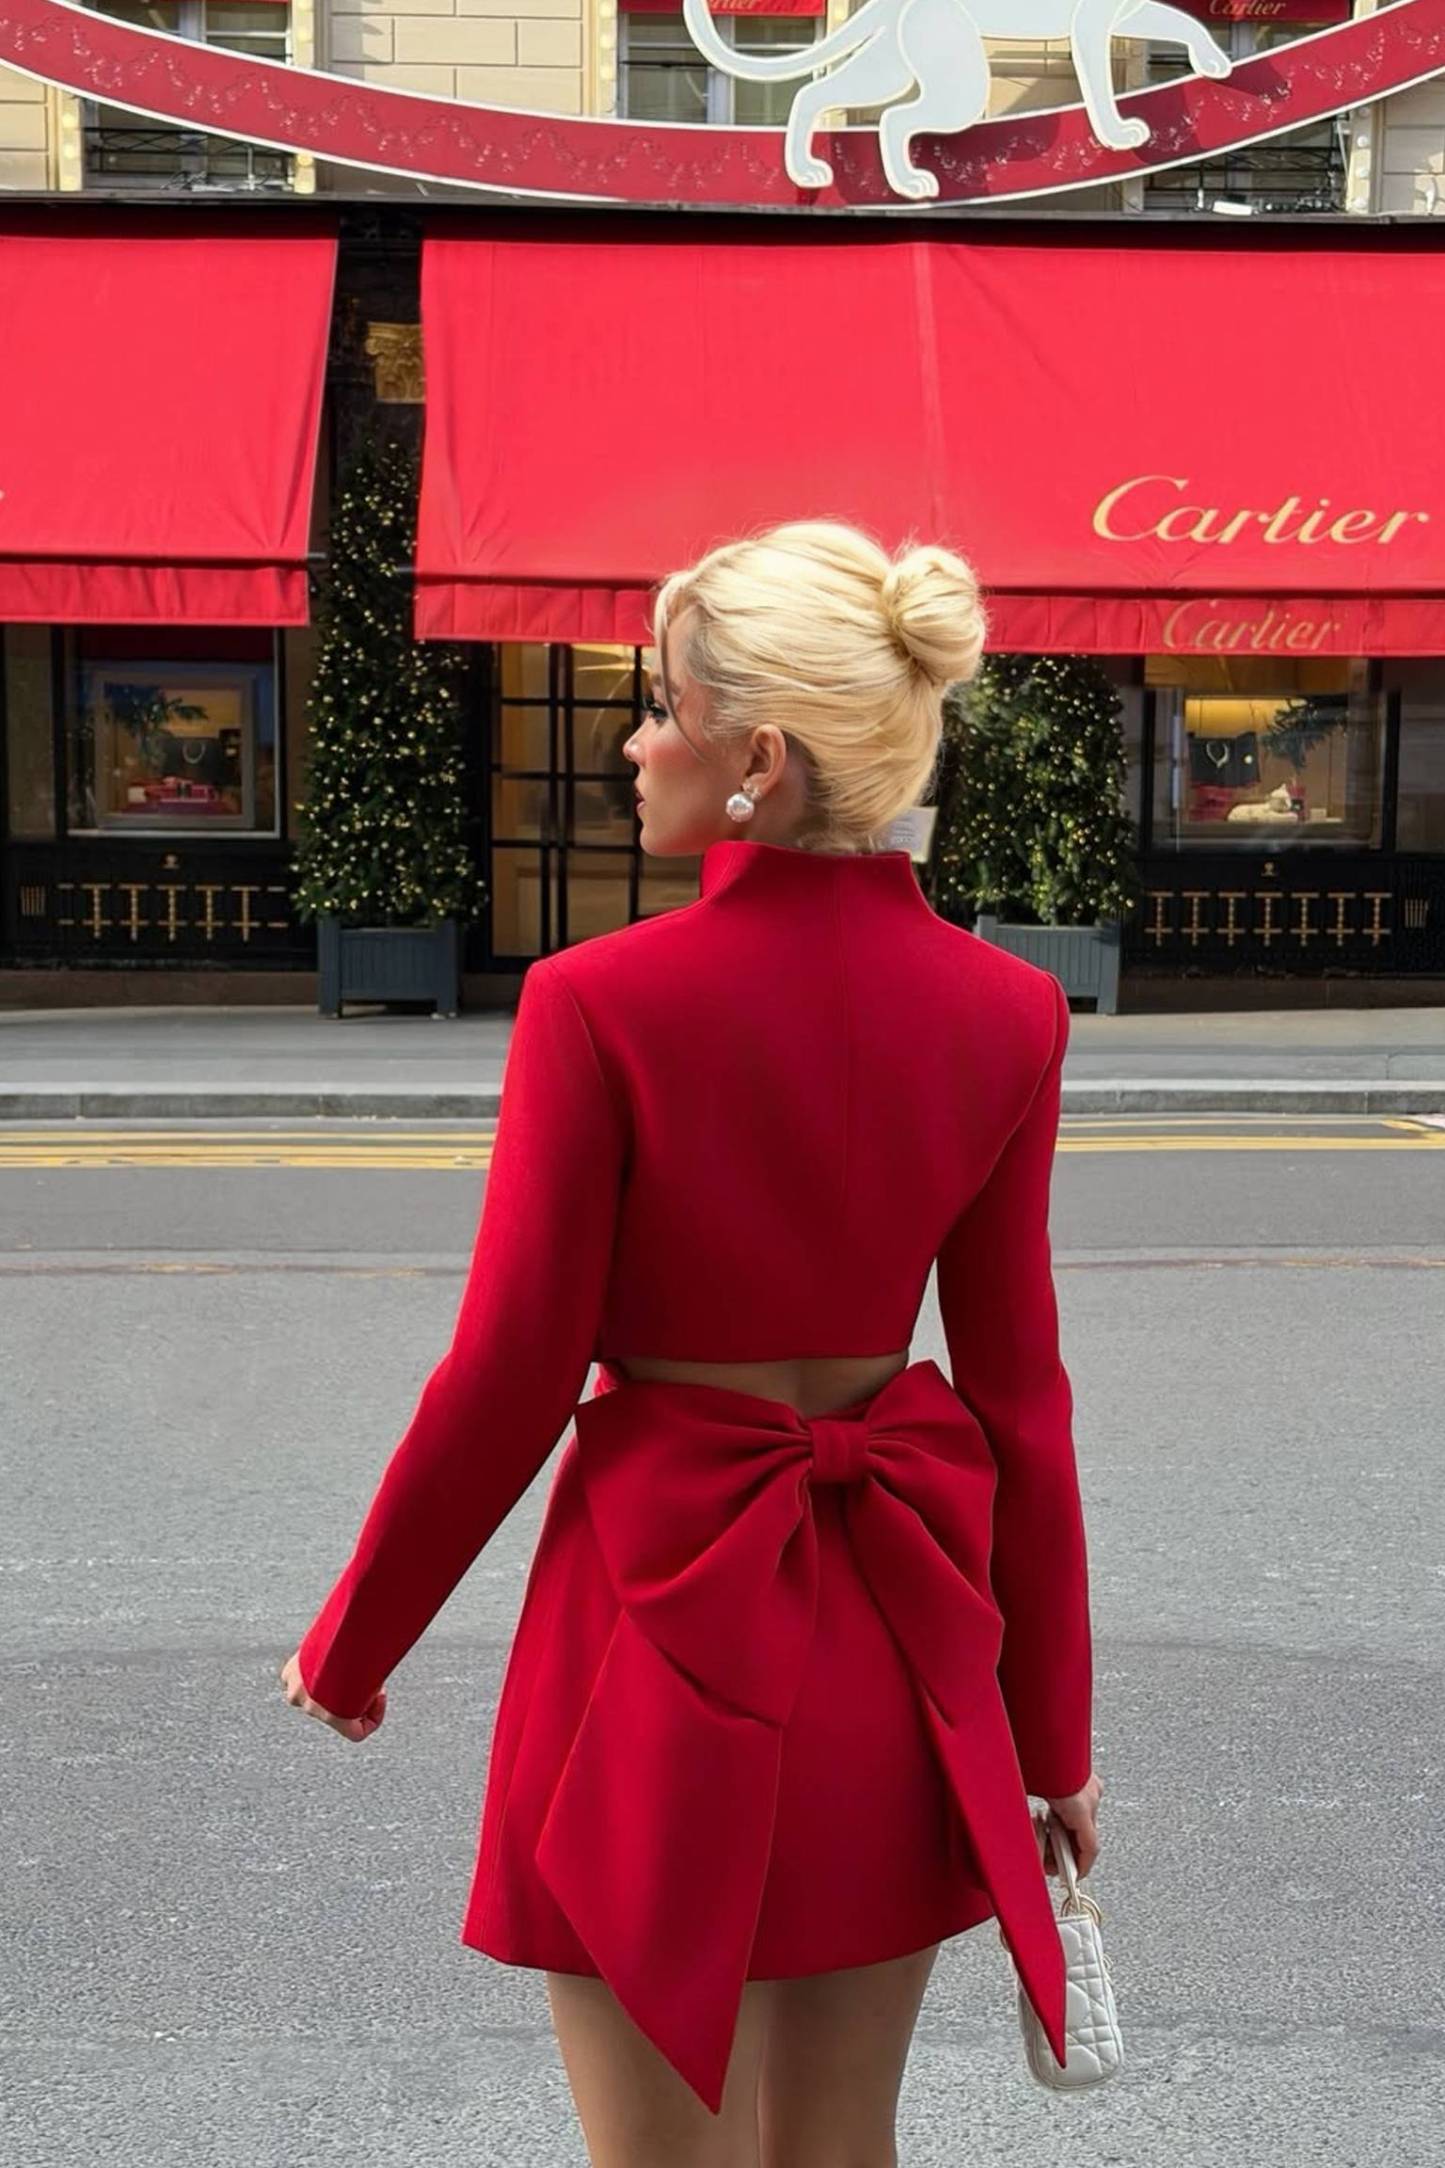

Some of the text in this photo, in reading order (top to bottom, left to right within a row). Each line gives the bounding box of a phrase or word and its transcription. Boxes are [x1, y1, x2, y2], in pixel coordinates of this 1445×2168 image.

[1208, 0, 1287, 15] Cartier
[1092, 475, 1430, 544] Cartier
[1163, 600, 1341, 650] Cartier
